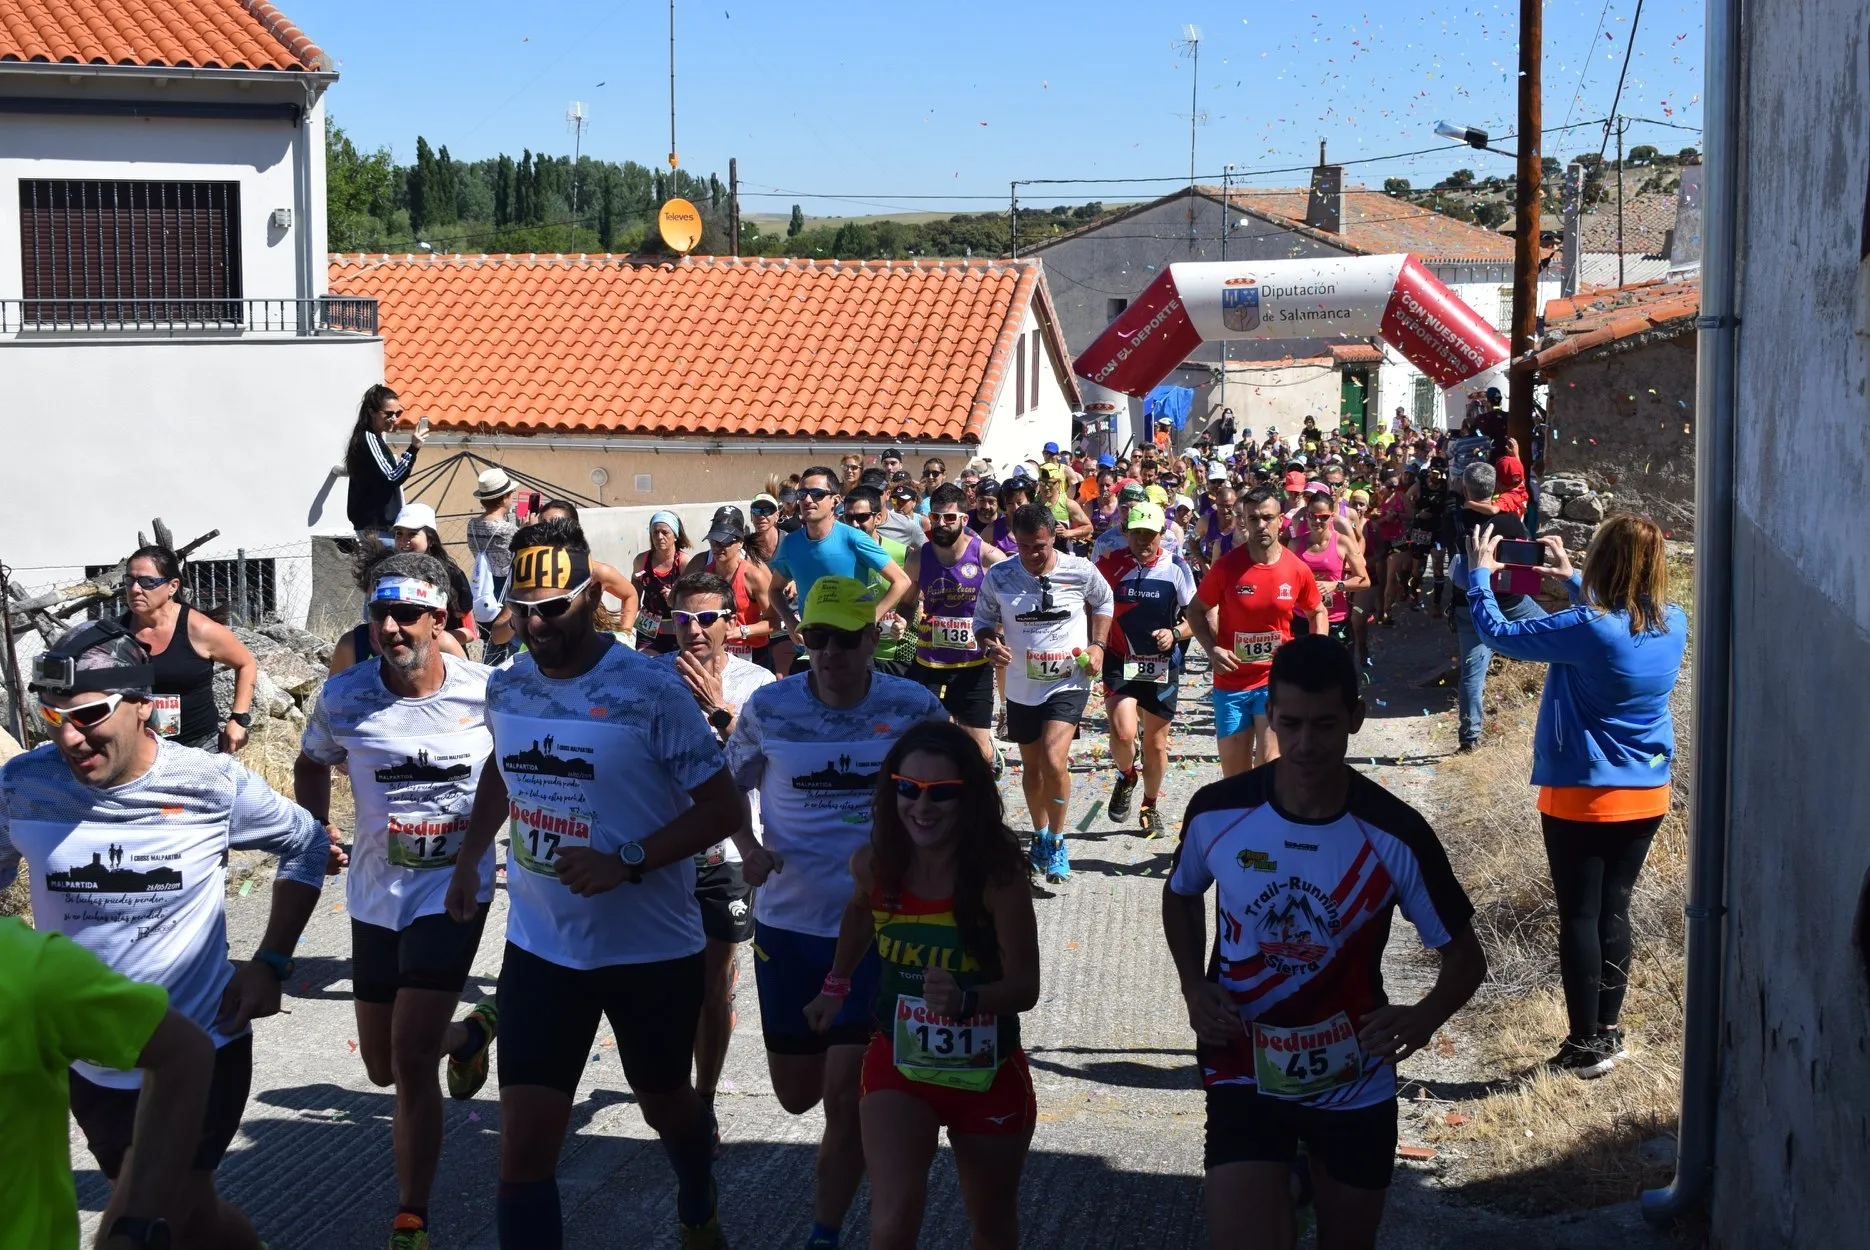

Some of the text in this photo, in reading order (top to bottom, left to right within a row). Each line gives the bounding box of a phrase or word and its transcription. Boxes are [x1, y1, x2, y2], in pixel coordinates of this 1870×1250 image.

[1261, 282, 1335, 300] Diputación
[1262, 308, 1351, 322] de Salamanca
[1094, 299, 1179, 382] CON EL DEPORTE
[1401, 294, 1485, 367] CON NUESTROS
[1396, 309, 1469, 373] DEPORTISTAS
[941, 629, 969, 643] 138
[1244, 641, 1272, 656] 183
[1040, 661, 1060, 675] 14
[1137, 661, 1156, 675] 88
[505, 762, 539, 771] MALPARTIDA
[389, 816, 469, 836] bedunia
[511, 800, 589, 839] bedunia
[414, 835, 447, 858] 12
[528, 828, 561, 861] 17
[151, 853, 181, 861] MALPARTIDA
[51, 881, 98, 889] MALPARTIDA
[76, 893, 102, 906] luchas
[103, 893, 132, 909] puedes
[1265, 954, 1320, 976] Sierra
[916, 1025, 972, 1054] 131
[1255, 1022, 1353, 1053] bedunia
[1286, 1047, 1329, 1080] 45
